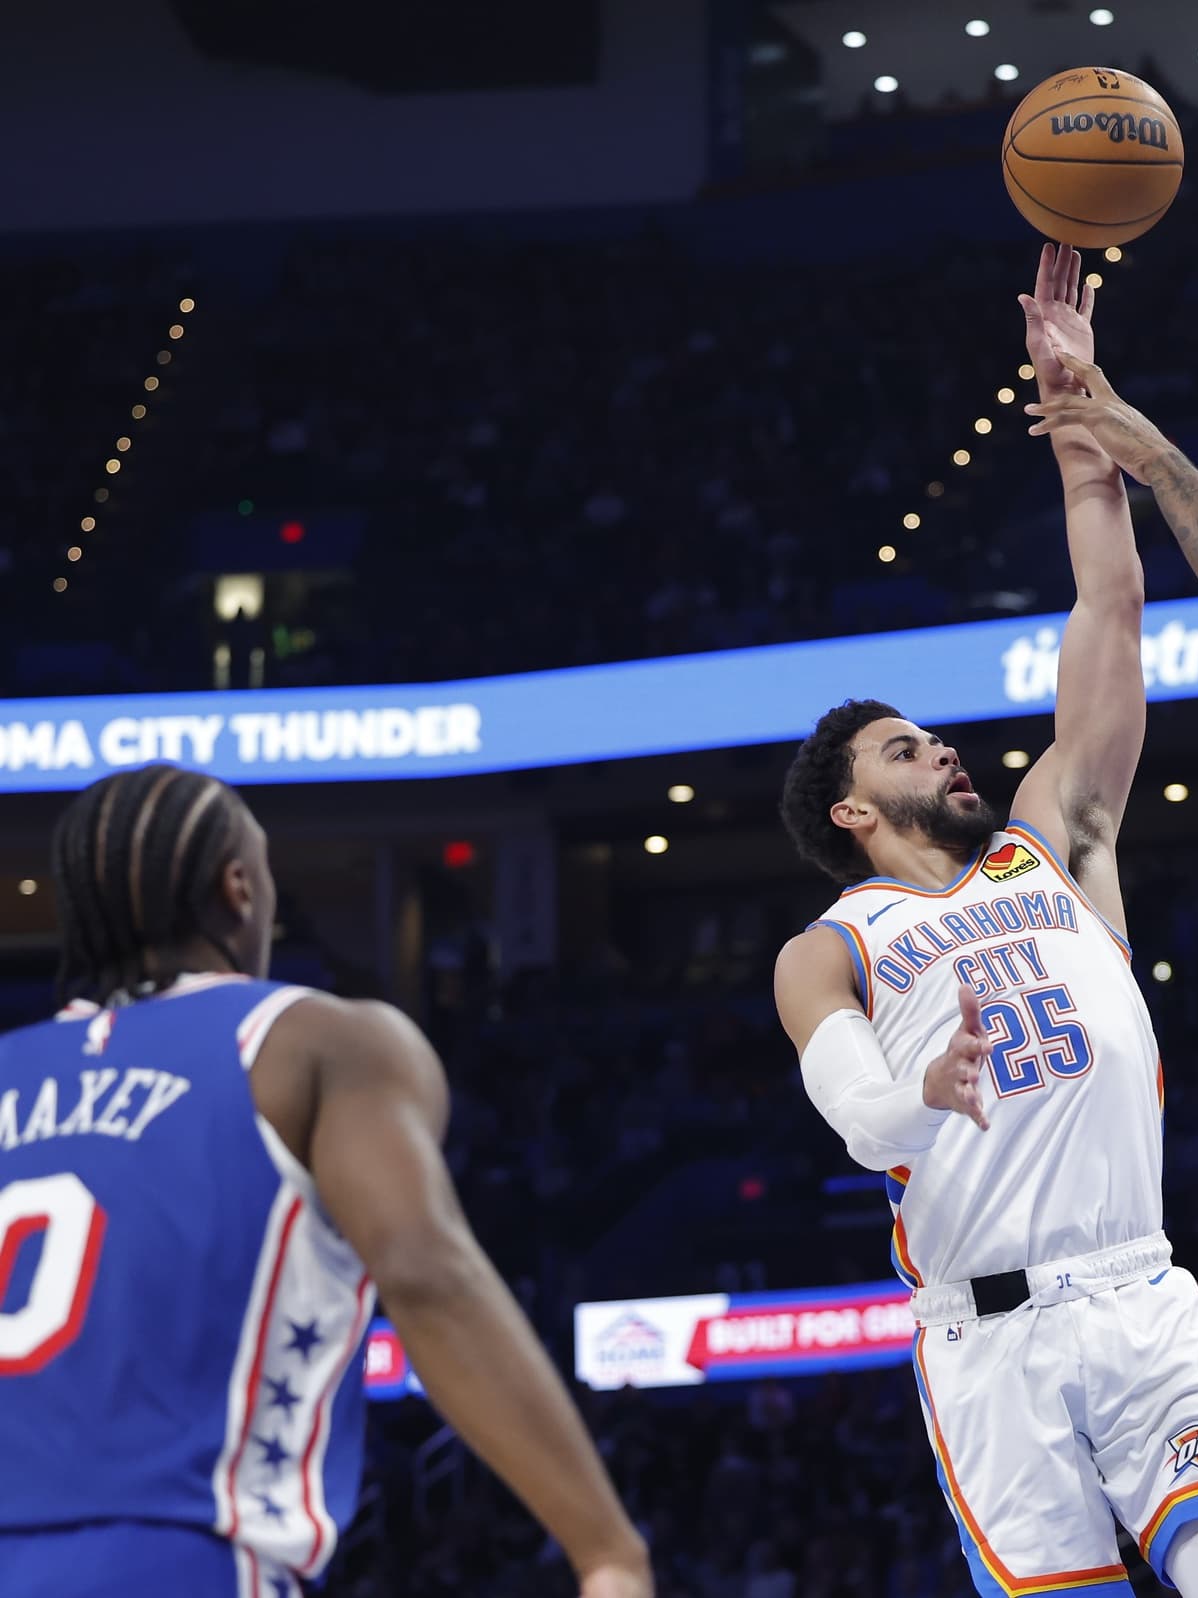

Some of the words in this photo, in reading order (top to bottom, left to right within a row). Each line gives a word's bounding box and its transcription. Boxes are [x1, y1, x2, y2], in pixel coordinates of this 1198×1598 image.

[1050, 112, 1168, 151] Wilson
[0, 719, 95, 771] MA
[100, 714, 224, 767] CITY
[230, 703, 481, 762] THUNDER
[874, 890, 1079, 994] OKLAHOMA
[952, 937, 1049, 999] CITY
[980, 983, 1094, 1099] 25
[0, 1172, 108, 1377] 0
[796, 1307, 863, 1348] FOR
